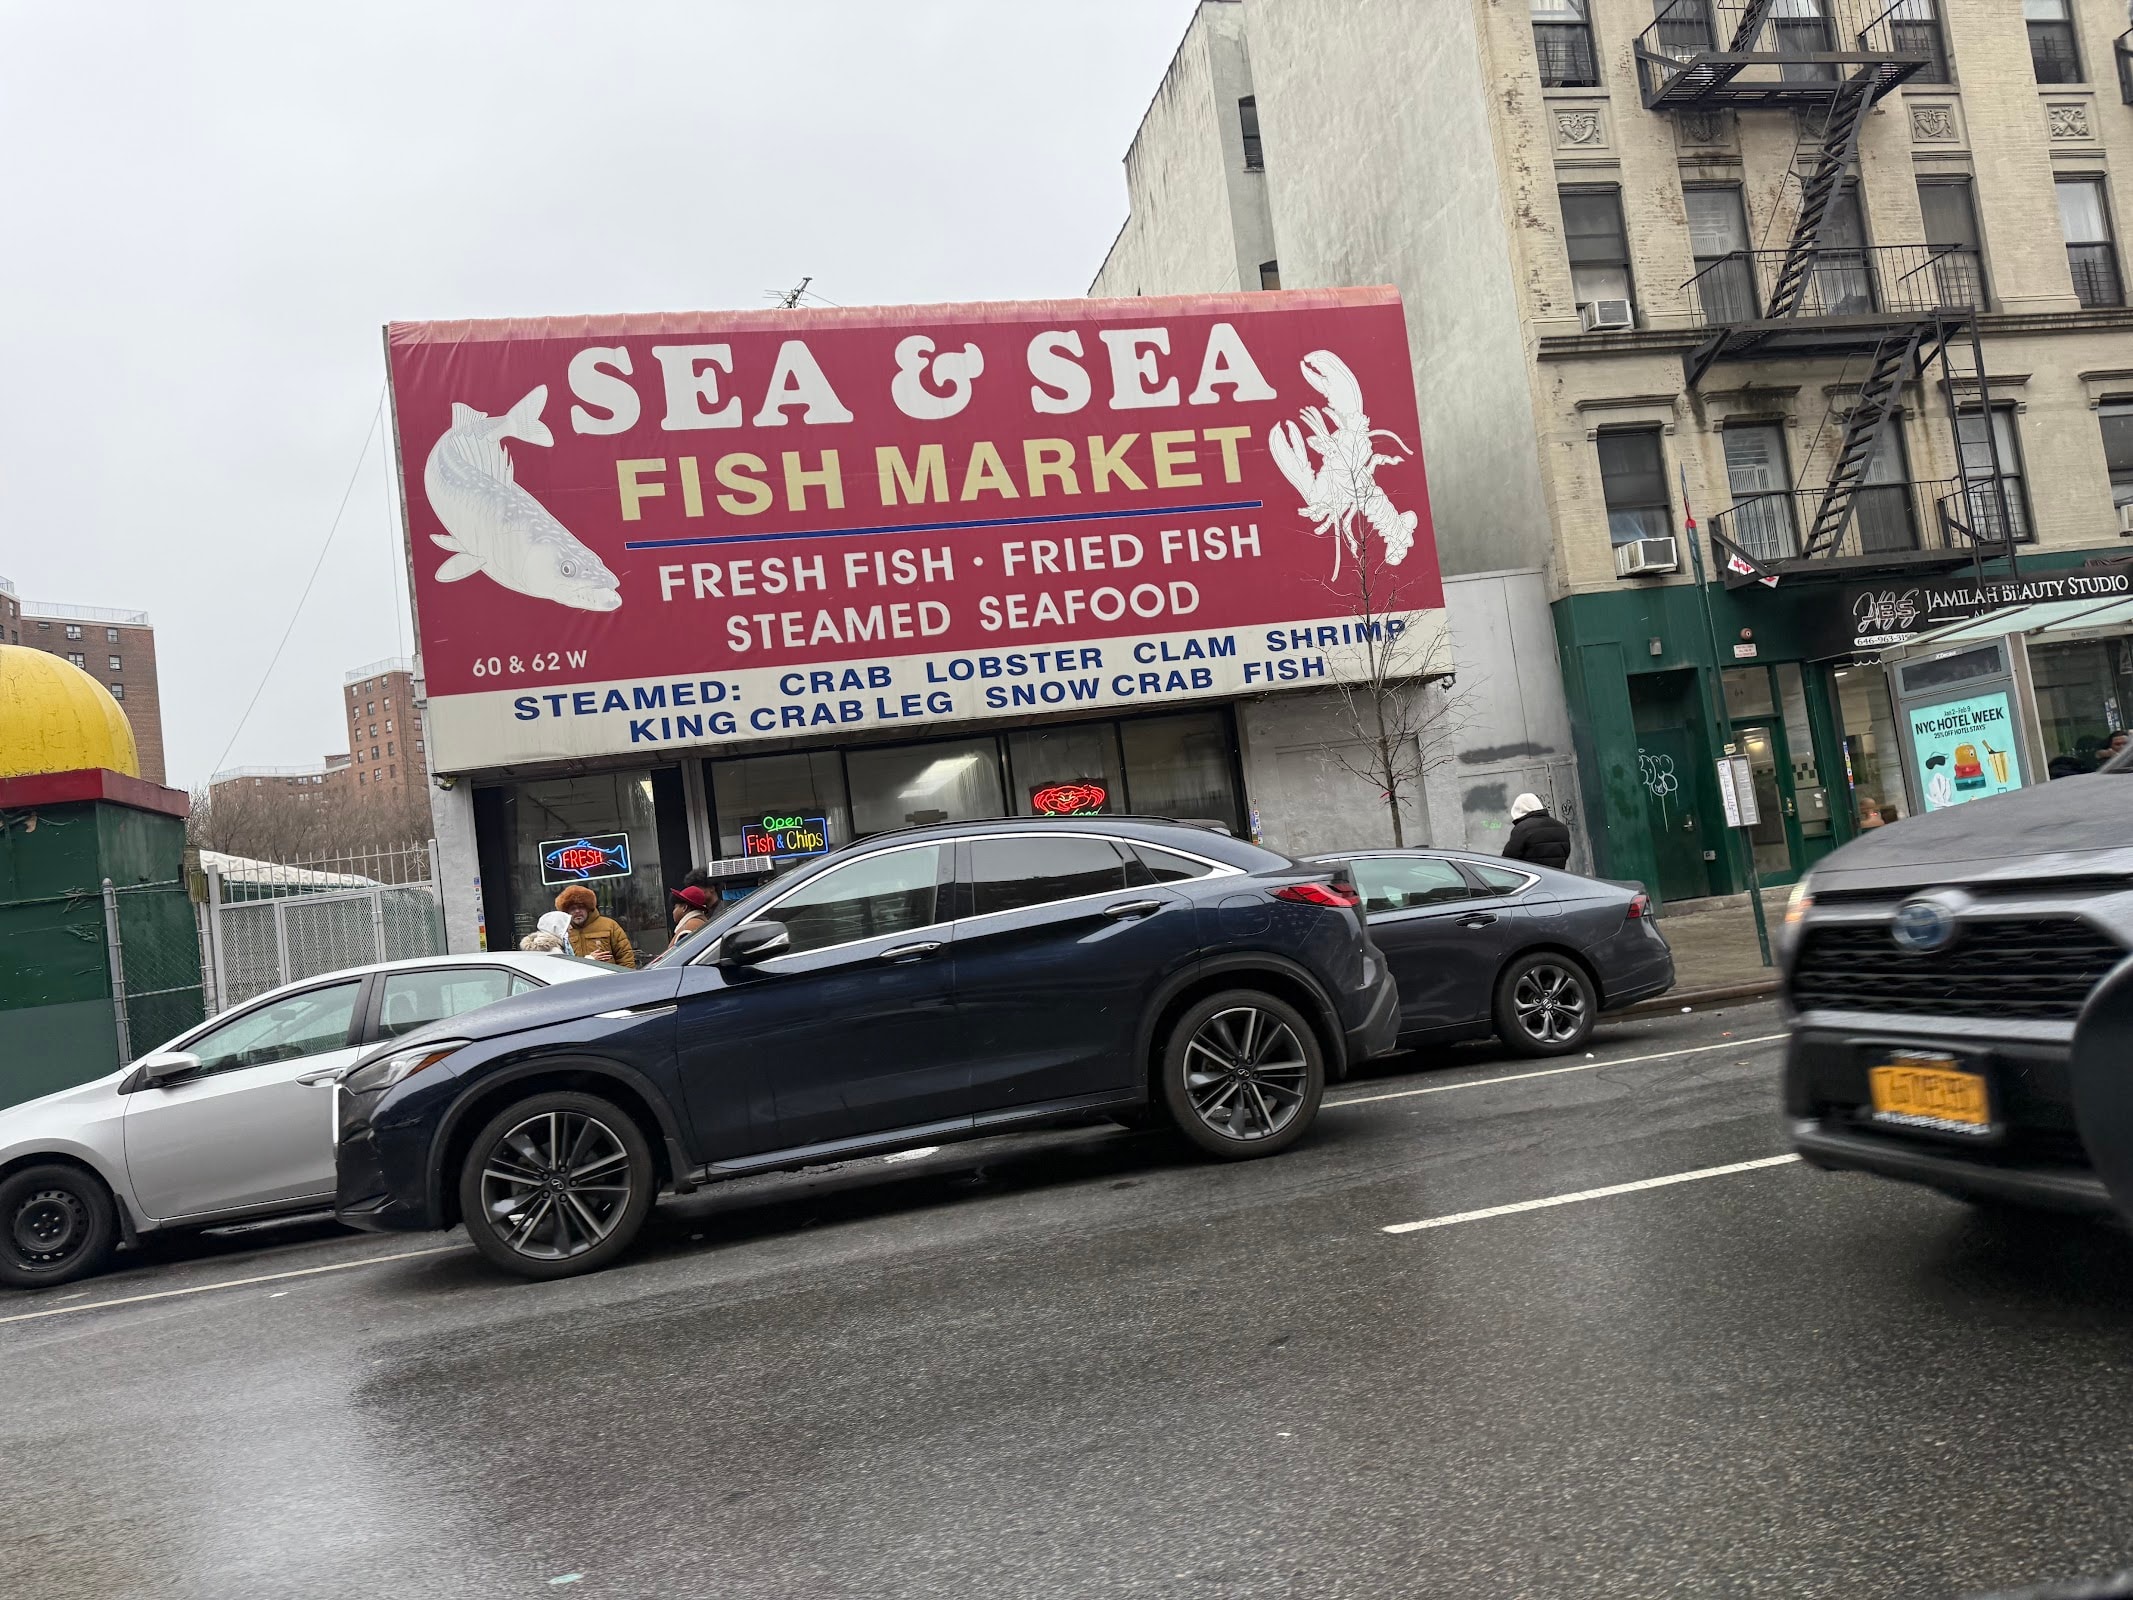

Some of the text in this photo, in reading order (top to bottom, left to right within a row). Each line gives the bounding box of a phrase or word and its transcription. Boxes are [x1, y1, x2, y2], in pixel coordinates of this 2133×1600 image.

[567, 322, 1278, 436] SEA & SEA
[615, 425, 1252, 521] FISH MARKET
[658, 523, 1262, 602] FRESH FISH FRIED FISH
[1925, 585, 2000, 613] JAMILAH
[2067, 574, 2130, 595] STUDIO
[726, 580, 1200, 652] STEAMED SEAFOOD
[472, 649, 588, 677] 60 & 62 W
[514, 618, 1407, 721] STEAMED: CRAB LOBSTER CLAM SHRIMP
[630, 656, 1326, 744] KING CRAB LEG SNOW CRAB FISH
[1915, 707, 2004, 735] NYC HOTEL WEEK
[1934, 731, 1945, 739] 25%
[1945, 729, 1954, 737] OFF
[1954, 727, 1970, 735] HOTEL
[746, 829, 824, 854] Fish & Chips
[763, 816, 803, 831] Open
[562, 849, 603, 869] FRESH
